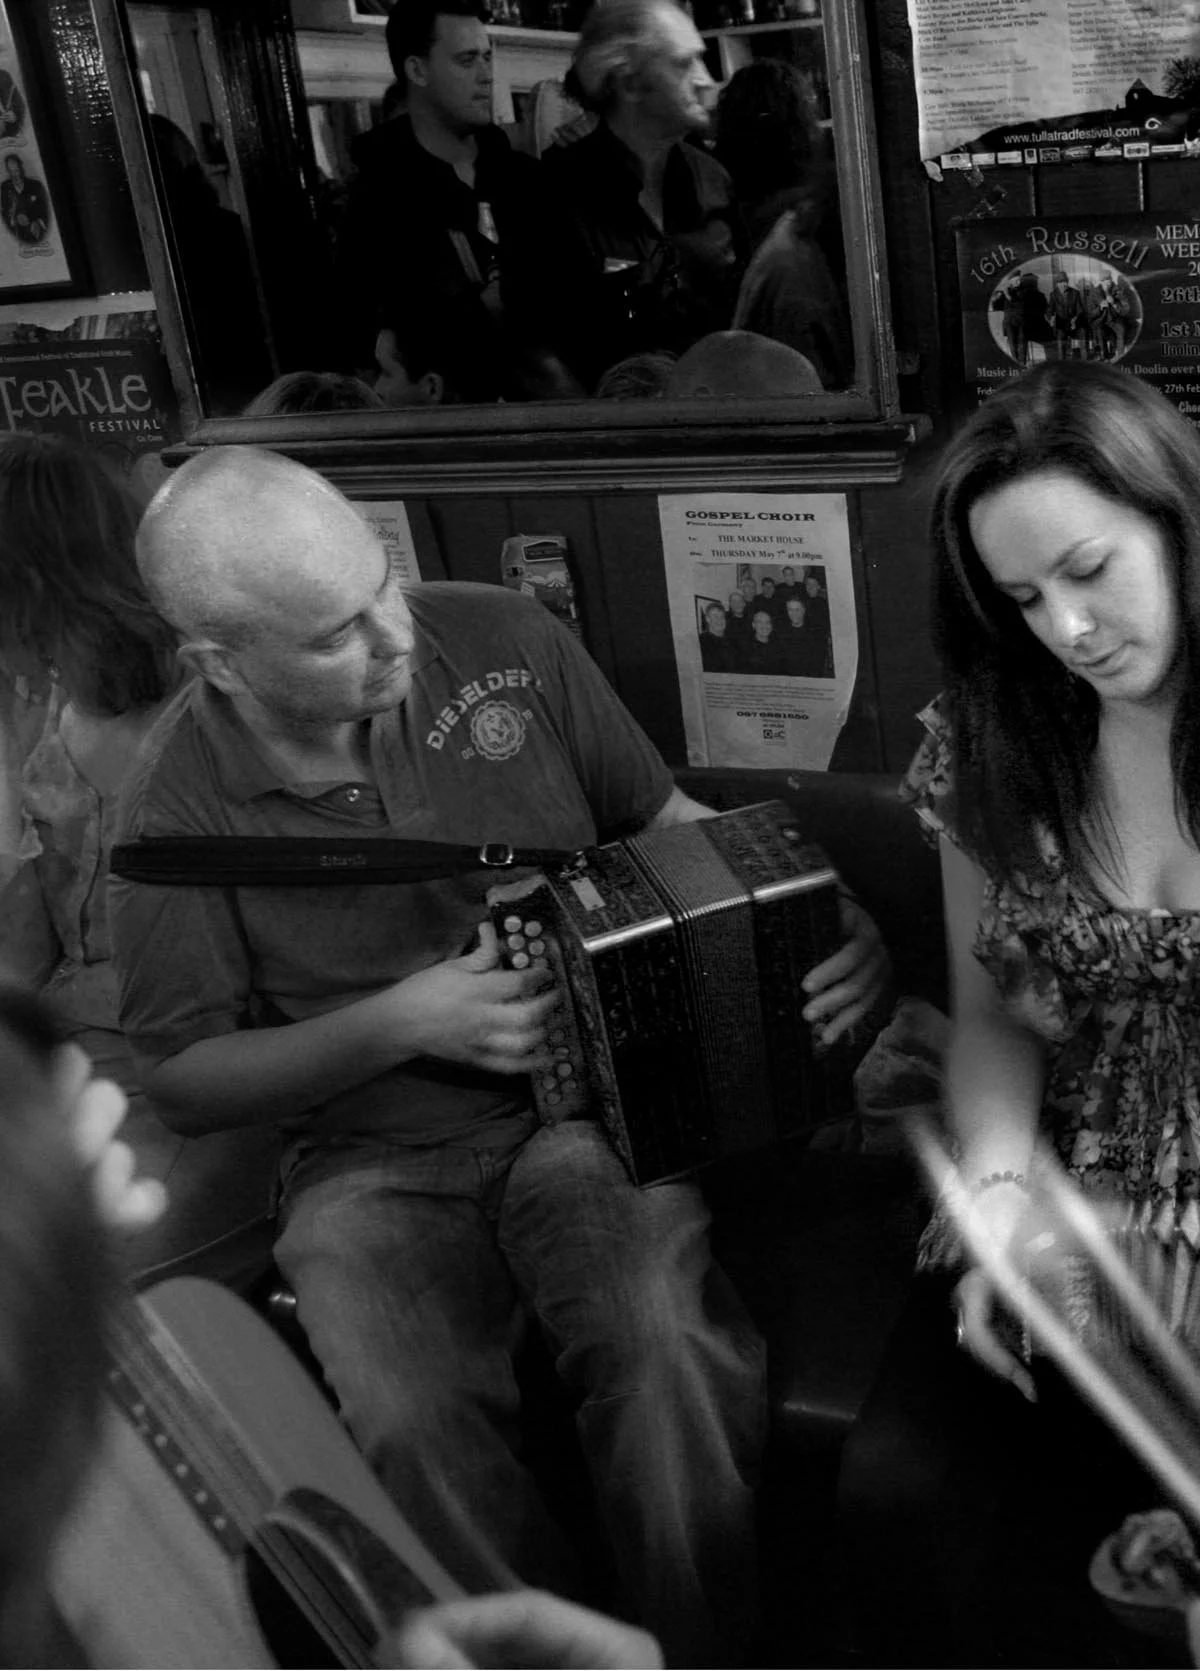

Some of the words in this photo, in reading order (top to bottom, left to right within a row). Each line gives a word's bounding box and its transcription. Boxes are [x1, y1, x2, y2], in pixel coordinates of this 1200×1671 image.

[1004, 126, 1140, 144] www.tullatradfestival.com
[970, 244, 1016, 283] 16th
[1026, 226, 1148, 268] Russell
[1161, 321, 1190, 337] 1st
[976, 367, 1006, 378] Music
[1008, 366, 1020, 376] in
[1134, 363, 1168, 374] Doolin
[1170, 365, 1195, 374] over
[1164, 384, 1184, 393] 27th
[88, 418, 162, 433] FESTIVAL
[686, 510, 756, 520] GOSPEL
[758, 512, 816, 522] CHOIR
[718, 535, 736, 543] THE
[738, 535, 774, 544] MARKET
[776, 536, 804, 544] HOUSE
[712, 550, 758, 558] THURSDAY
